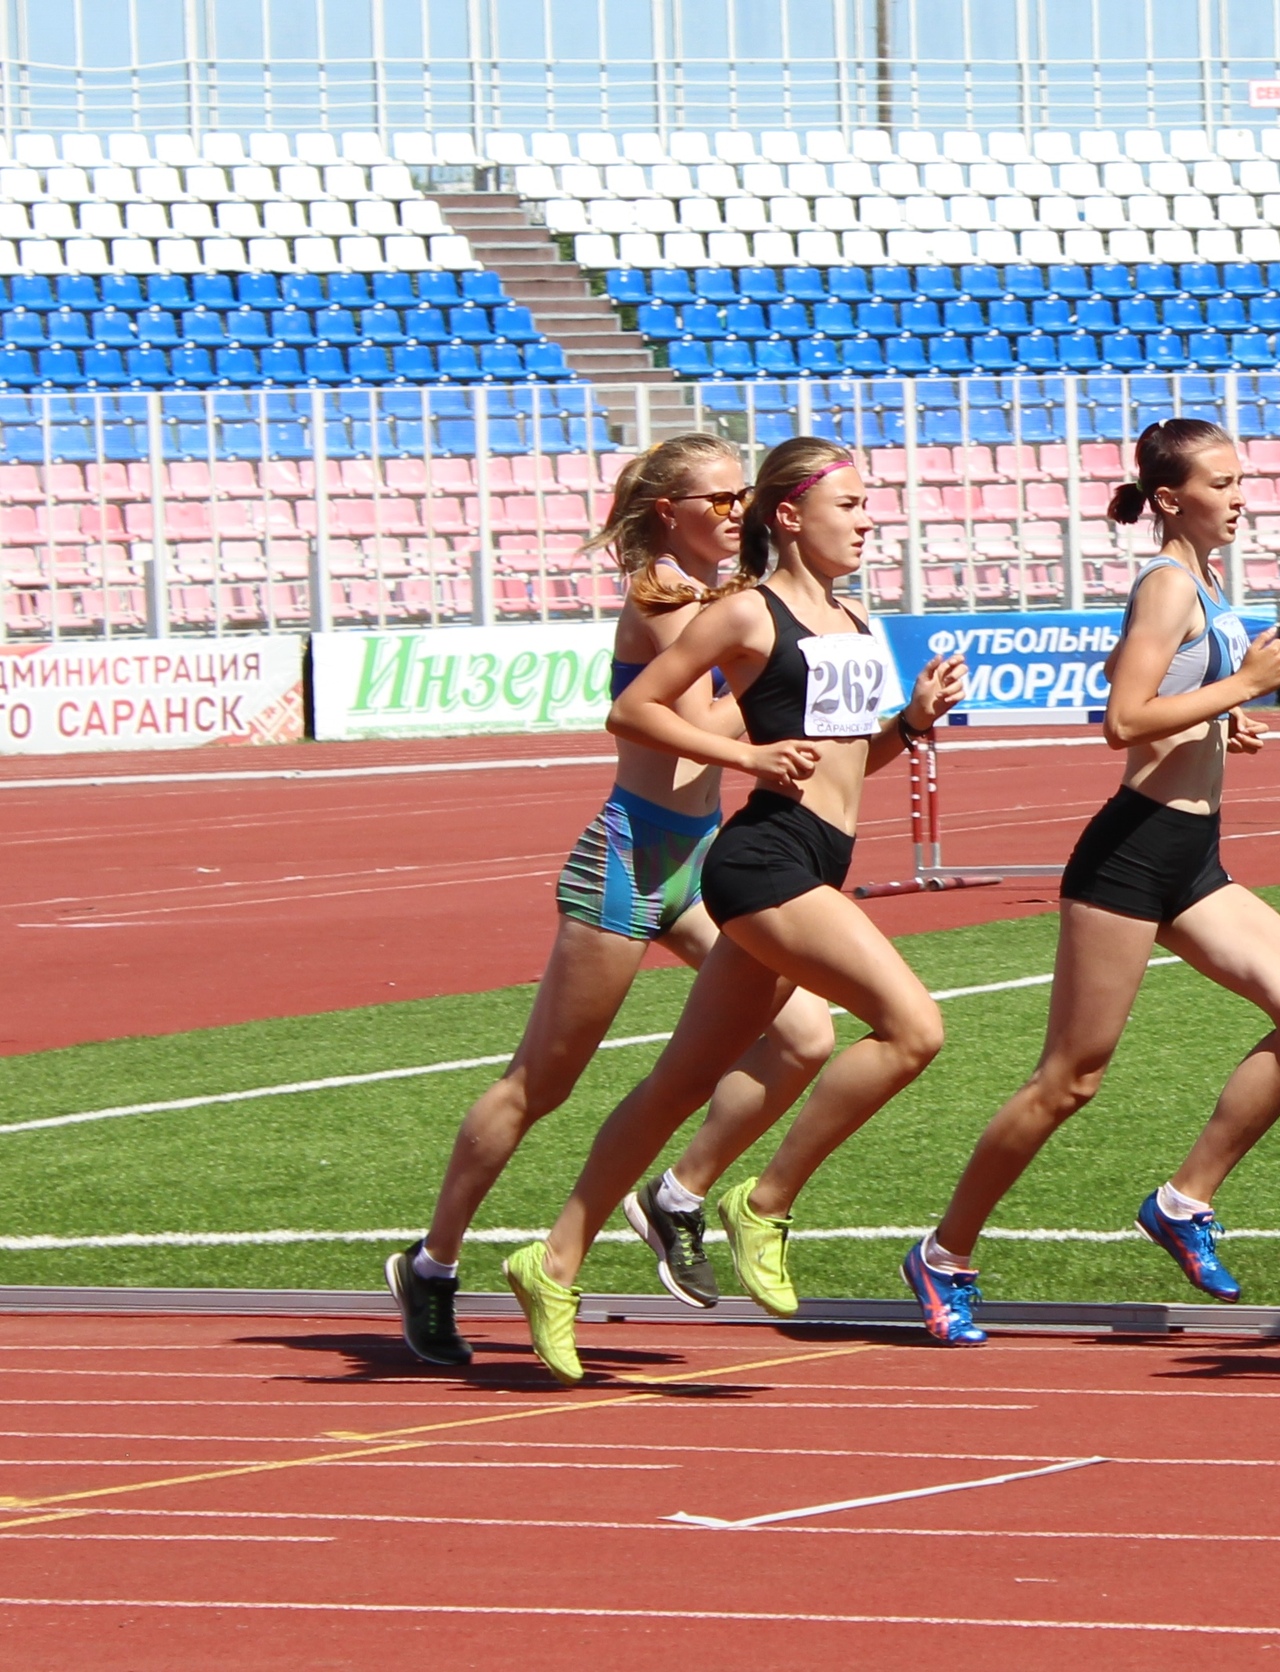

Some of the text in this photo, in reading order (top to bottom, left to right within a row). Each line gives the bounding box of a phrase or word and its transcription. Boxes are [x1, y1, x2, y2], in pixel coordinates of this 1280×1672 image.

[348, 635, 614, 725] Инзера
[811, 659, 883, 714] 262
[962, 661, 1112, 707] МОРДО
[58, 695, 244, 738] САРАНСК
